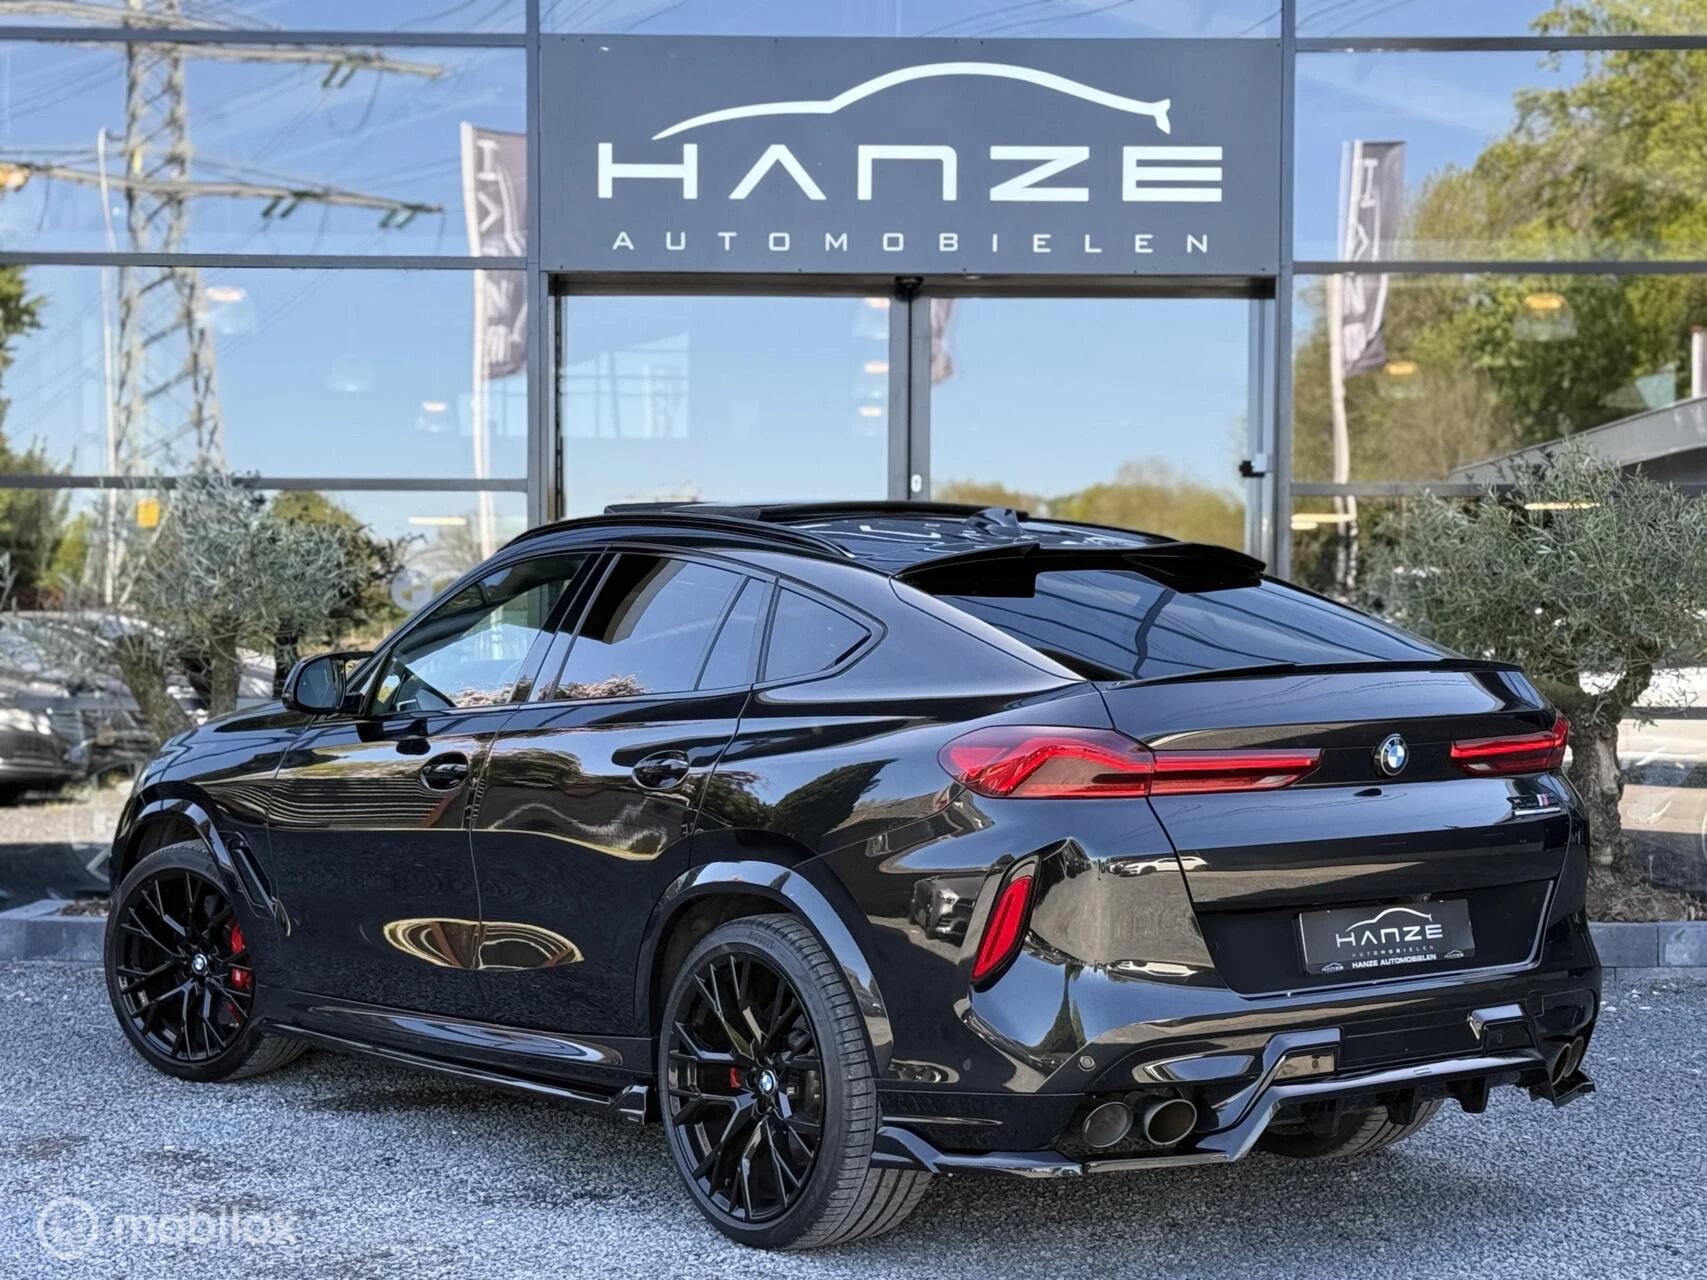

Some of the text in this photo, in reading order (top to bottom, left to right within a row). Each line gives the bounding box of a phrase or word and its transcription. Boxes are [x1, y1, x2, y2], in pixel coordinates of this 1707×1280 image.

[597, 142, 1223, 202] HANZE
[612, 231, 1209, 254] AUTOMOBIELEN
[1335, 924, 1444, 948] HANZE
[1352, 959, 1379, 969] HANZE
[1379, 953, 1437, 967] AUTOMOBIELEN
